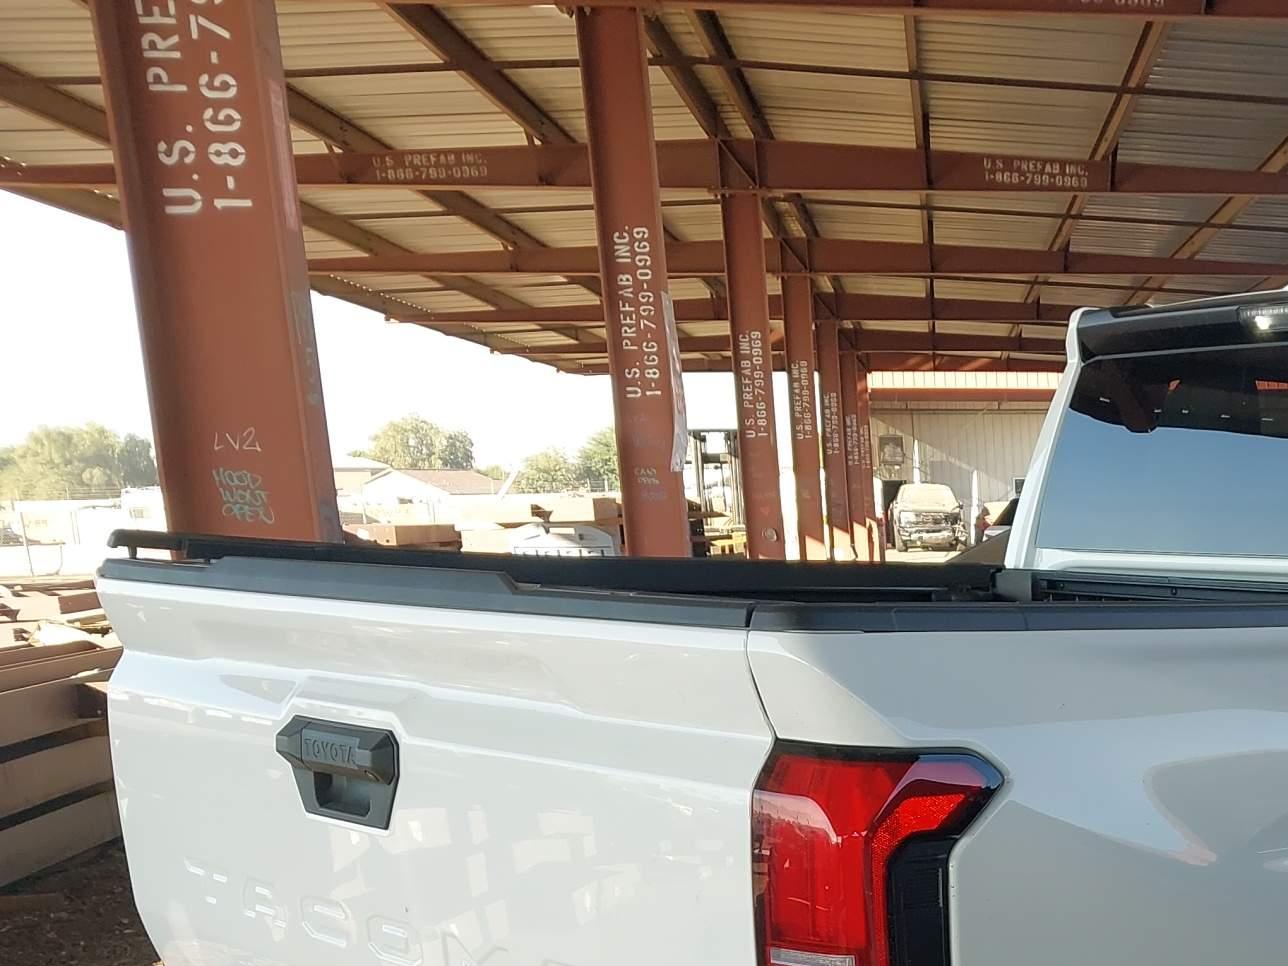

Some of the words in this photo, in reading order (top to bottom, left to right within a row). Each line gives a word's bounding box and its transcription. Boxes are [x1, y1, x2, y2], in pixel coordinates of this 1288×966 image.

[188, 0, 253, 210] 1-866-7
[157, 124, 202, 214] U.S.
[404, 153, 455, 166] PREFAB
[1013, 160, 1060, 174] PREFAB
[613, 225, 632, 263] INC.
[617, 273, 638, 351] PREFAB
[633, 226, 661, 396] 1-866-799-0969
[739, 330, 751, 354] INC.
[625, 361, 642, 398] U.S.
[741, 360, 754, 408] PREFAB
[751, 331, 768, 436] 1-866-799-0969
[745, 415, 756, 438] U.S.
[304, 738, 357, 765] TOYOTA
